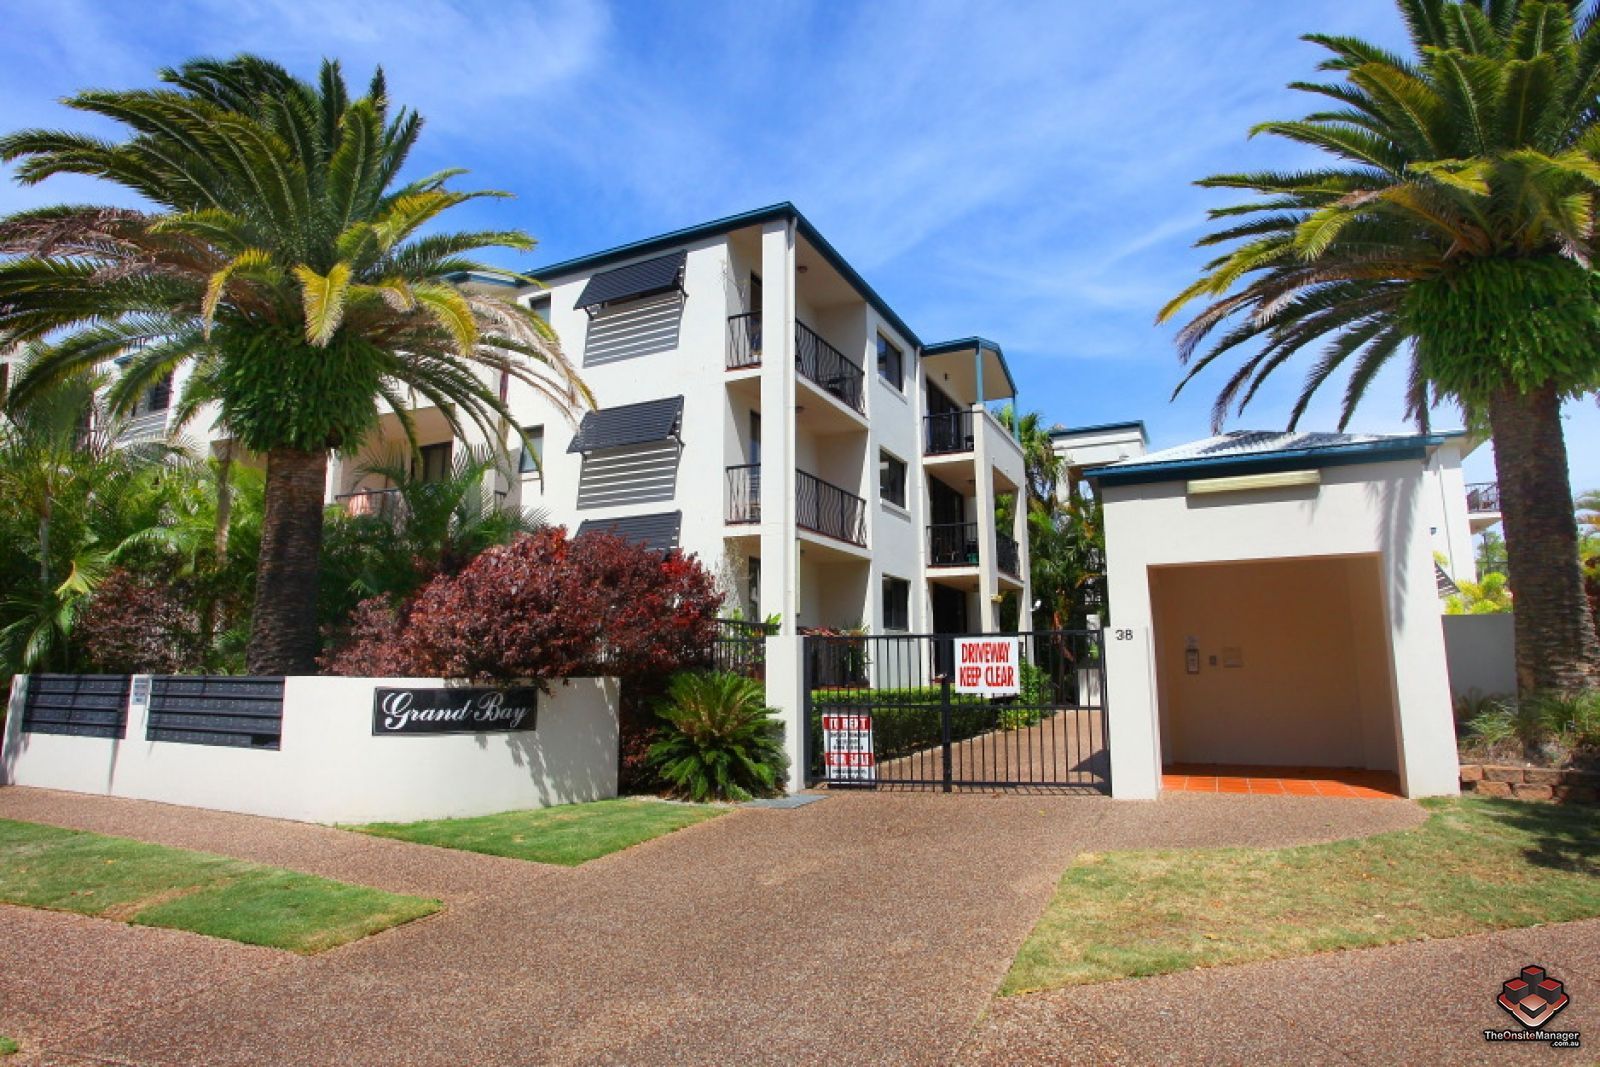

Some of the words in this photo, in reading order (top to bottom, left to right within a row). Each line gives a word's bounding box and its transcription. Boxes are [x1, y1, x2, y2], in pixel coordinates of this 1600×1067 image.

[1115, 629, 1133, 641] 38
[961, 641, 1011, 664] DRIVEWAY
[959, 666, 981, 687] KEEP
[985, 665, 1014, 687] CLEAR
[382, 691, 472, 730] Grand
[473, 691, 528, 728] Bay
